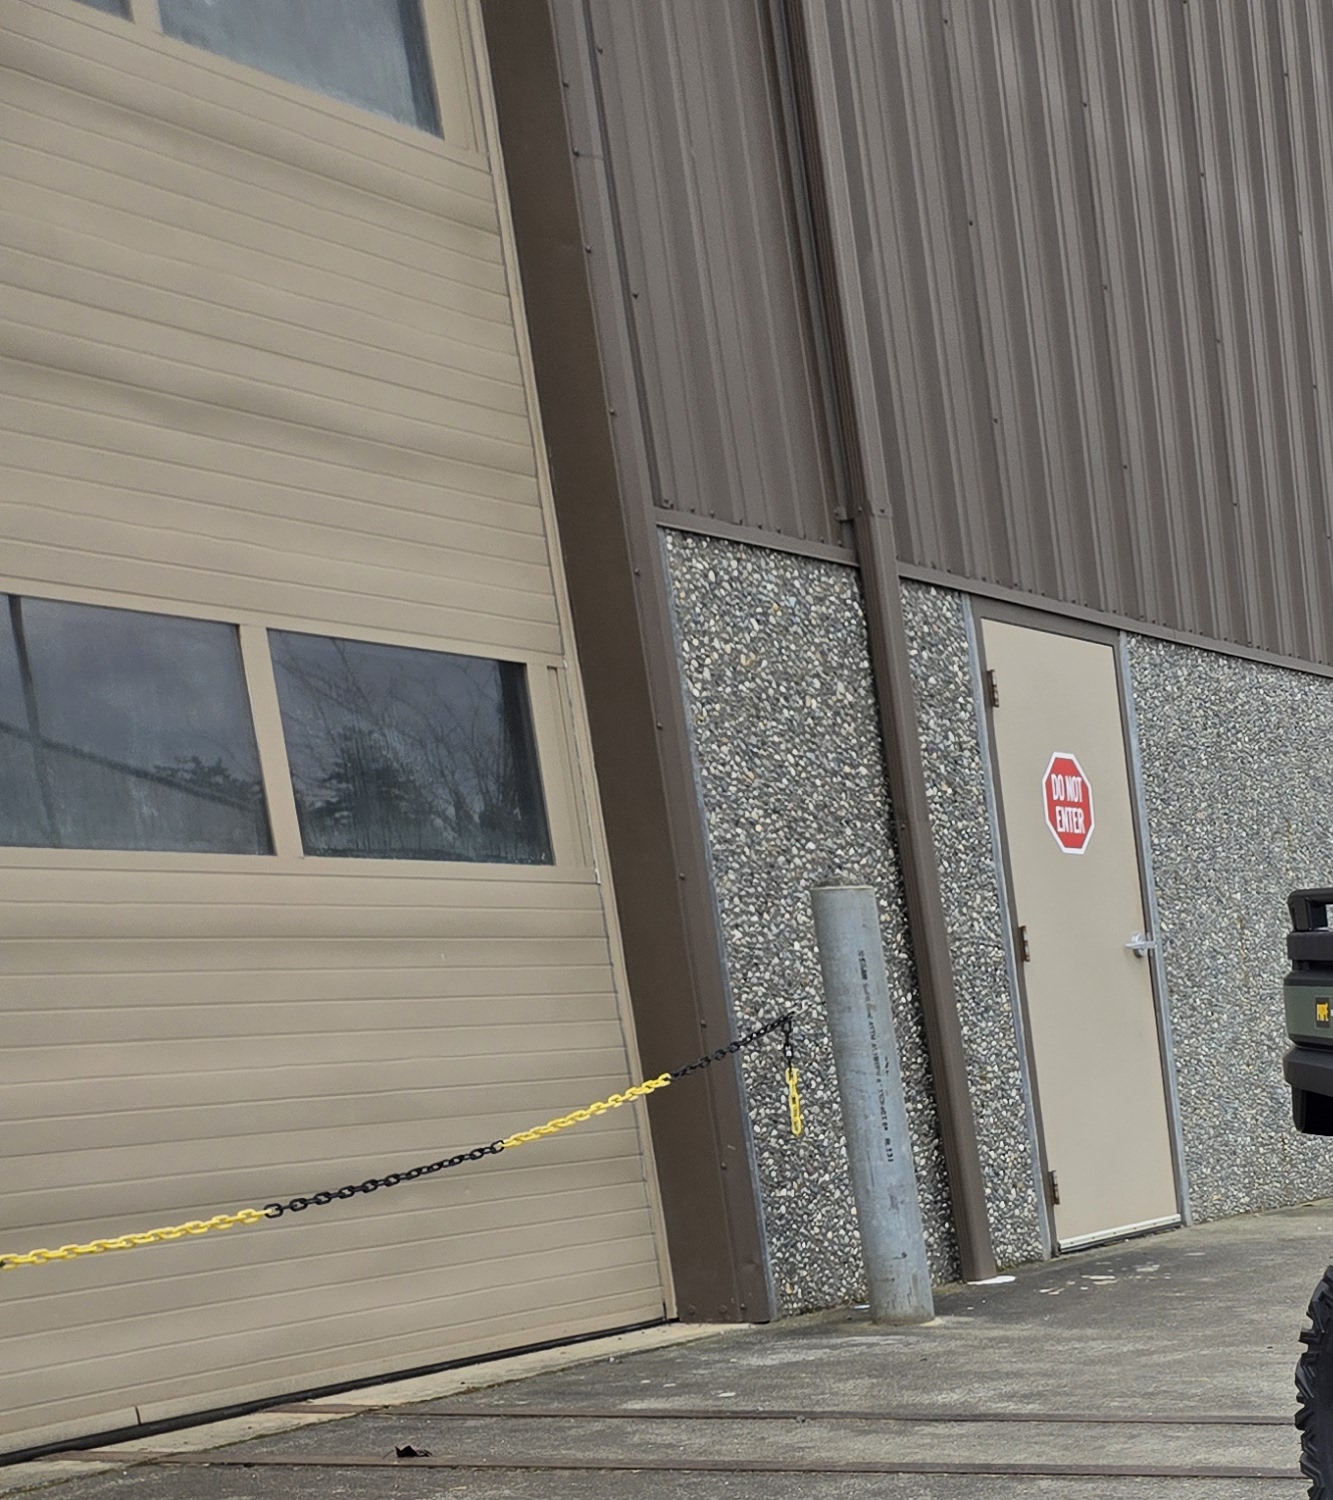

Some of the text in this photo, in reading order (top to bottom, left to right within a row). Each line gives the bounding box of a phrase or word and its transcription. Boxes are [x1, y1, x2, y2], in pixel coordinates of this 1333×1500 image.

[1051, 774, 1082, 803] DO NOT
[1055, 806, 1086, 834] ENTER
